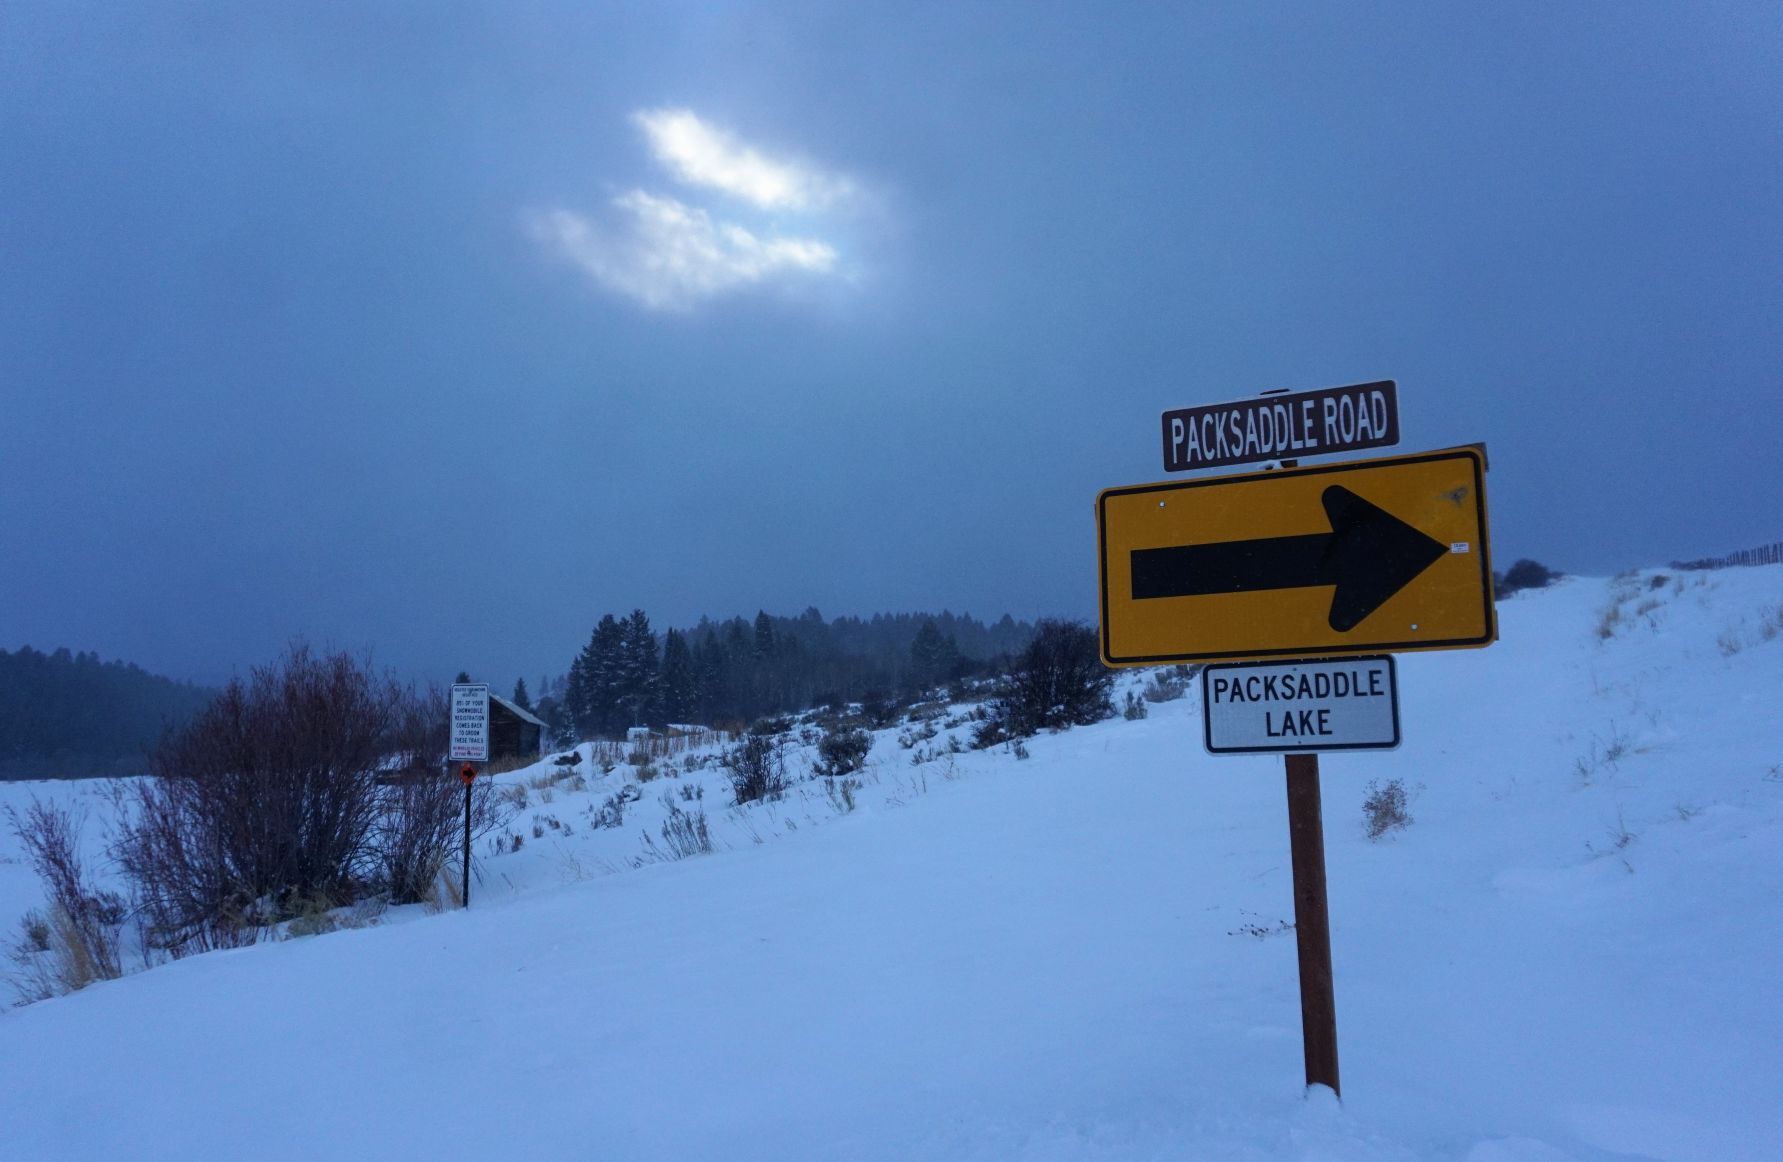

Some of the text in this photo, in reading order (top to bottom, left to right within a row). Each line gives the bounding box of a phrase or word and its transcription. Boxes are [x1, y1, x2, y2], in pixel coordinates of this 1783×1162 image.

[1171, 390, 1388, 464] PACKSADDLE ROAD
[1214, 670, 1385, 703] PACKSADDLE
[1266, 709, 1333, 737] LAKE
